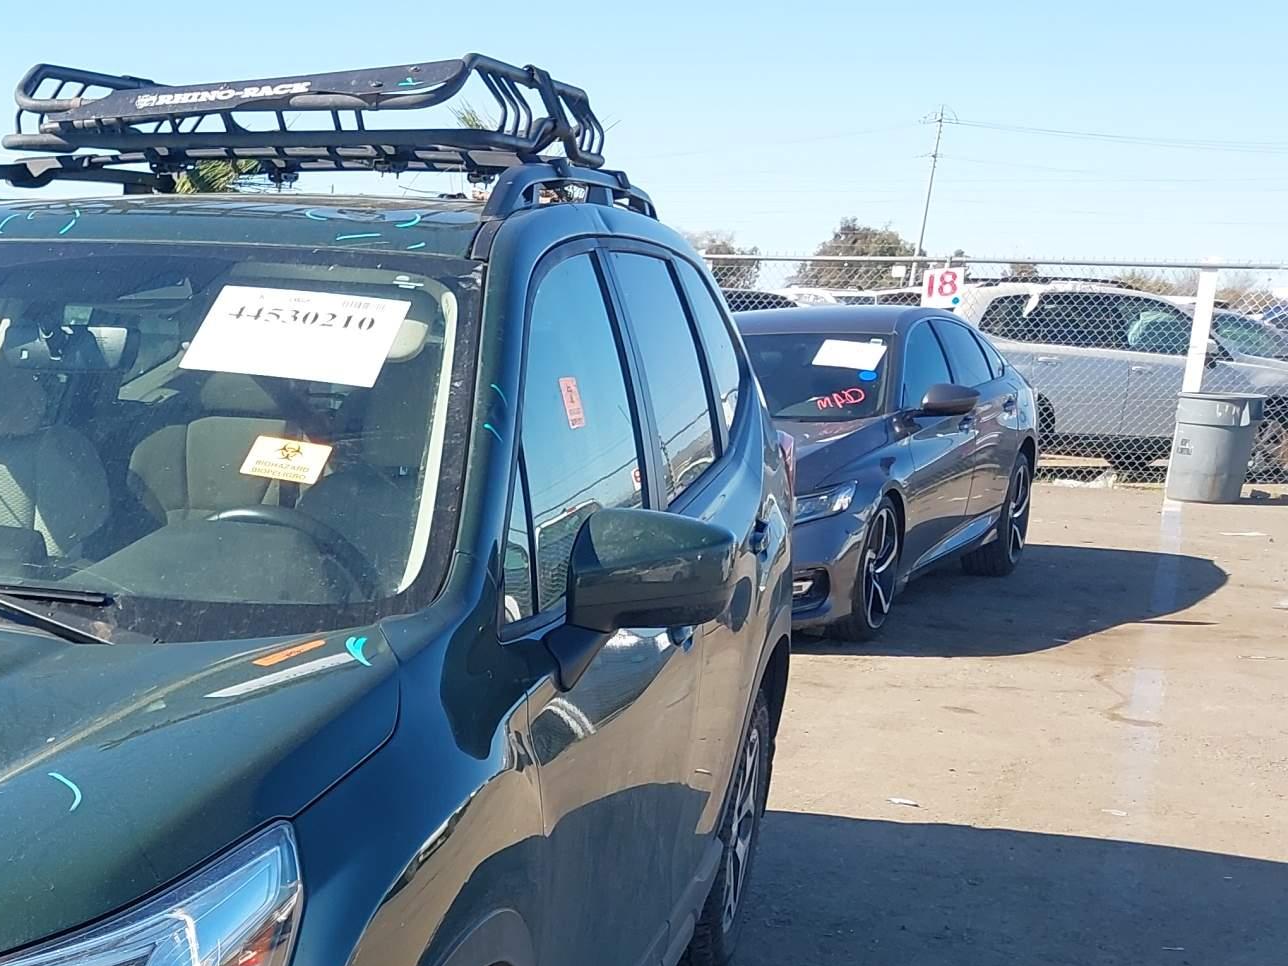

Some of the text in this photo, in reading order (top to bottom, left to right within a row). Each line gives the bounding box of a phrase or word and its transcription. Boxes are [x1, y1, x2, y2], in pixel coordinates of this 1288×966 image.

[157, 82, 311, 105] RHINO-RACK
[927, 271, 958, 298] 18
[228, 305, 375, 331] 44530210
